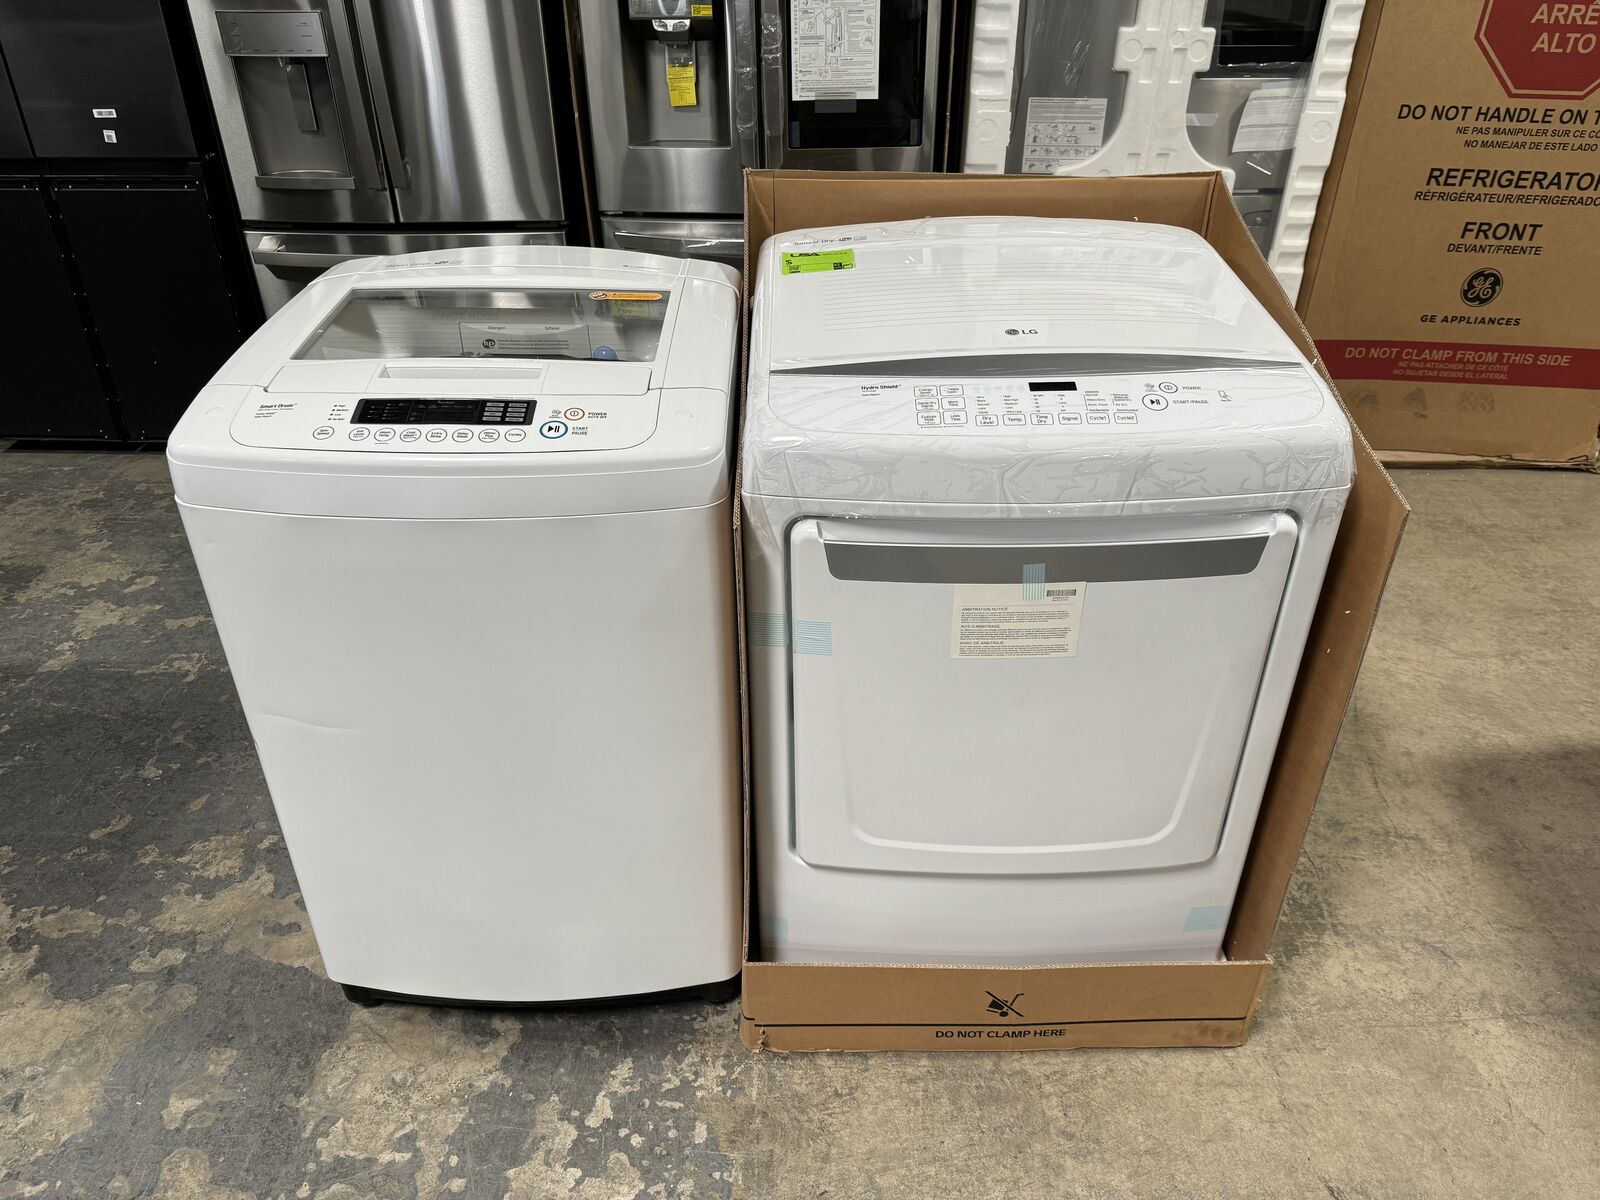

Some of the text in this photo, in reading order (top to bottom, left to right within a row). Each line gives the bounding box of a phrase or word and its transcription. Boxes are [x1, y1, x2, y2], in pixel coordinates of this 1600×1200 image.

[1531, 32, 1597, 54] ALTO
[1397, 104, 1426, 120] DO
[1430, 105, 1473, 122] NOT
[1475, 106, 1555, 124] HANDLE
[1559, 109, 1588, 125] ON
[1456, 126, 1470, 135] NE
[1471, 127, 1491, 136] PAS
[1492, 128, 1549, 138] MANIPULER
[1550, 129, 1572, 138] SUR
[1572, 130, 1588, 139] CE
[1464, 140, 1598, 152] NO MANEJAR DE ESTE LADO
[1460, 222, 1543, 241] FRONT
[1446, 243, 1543, 255] DEVANT/FRENTE
[1420, 314, 1521, 326] GE APPLIANCES
[1344, 347, 1572, 367] DO NOT CLAMP FROM THIS SIDE
[987, 1030, 1031, 1038] CLAMP
[1033, 1029, 1067, 1037] HERE
